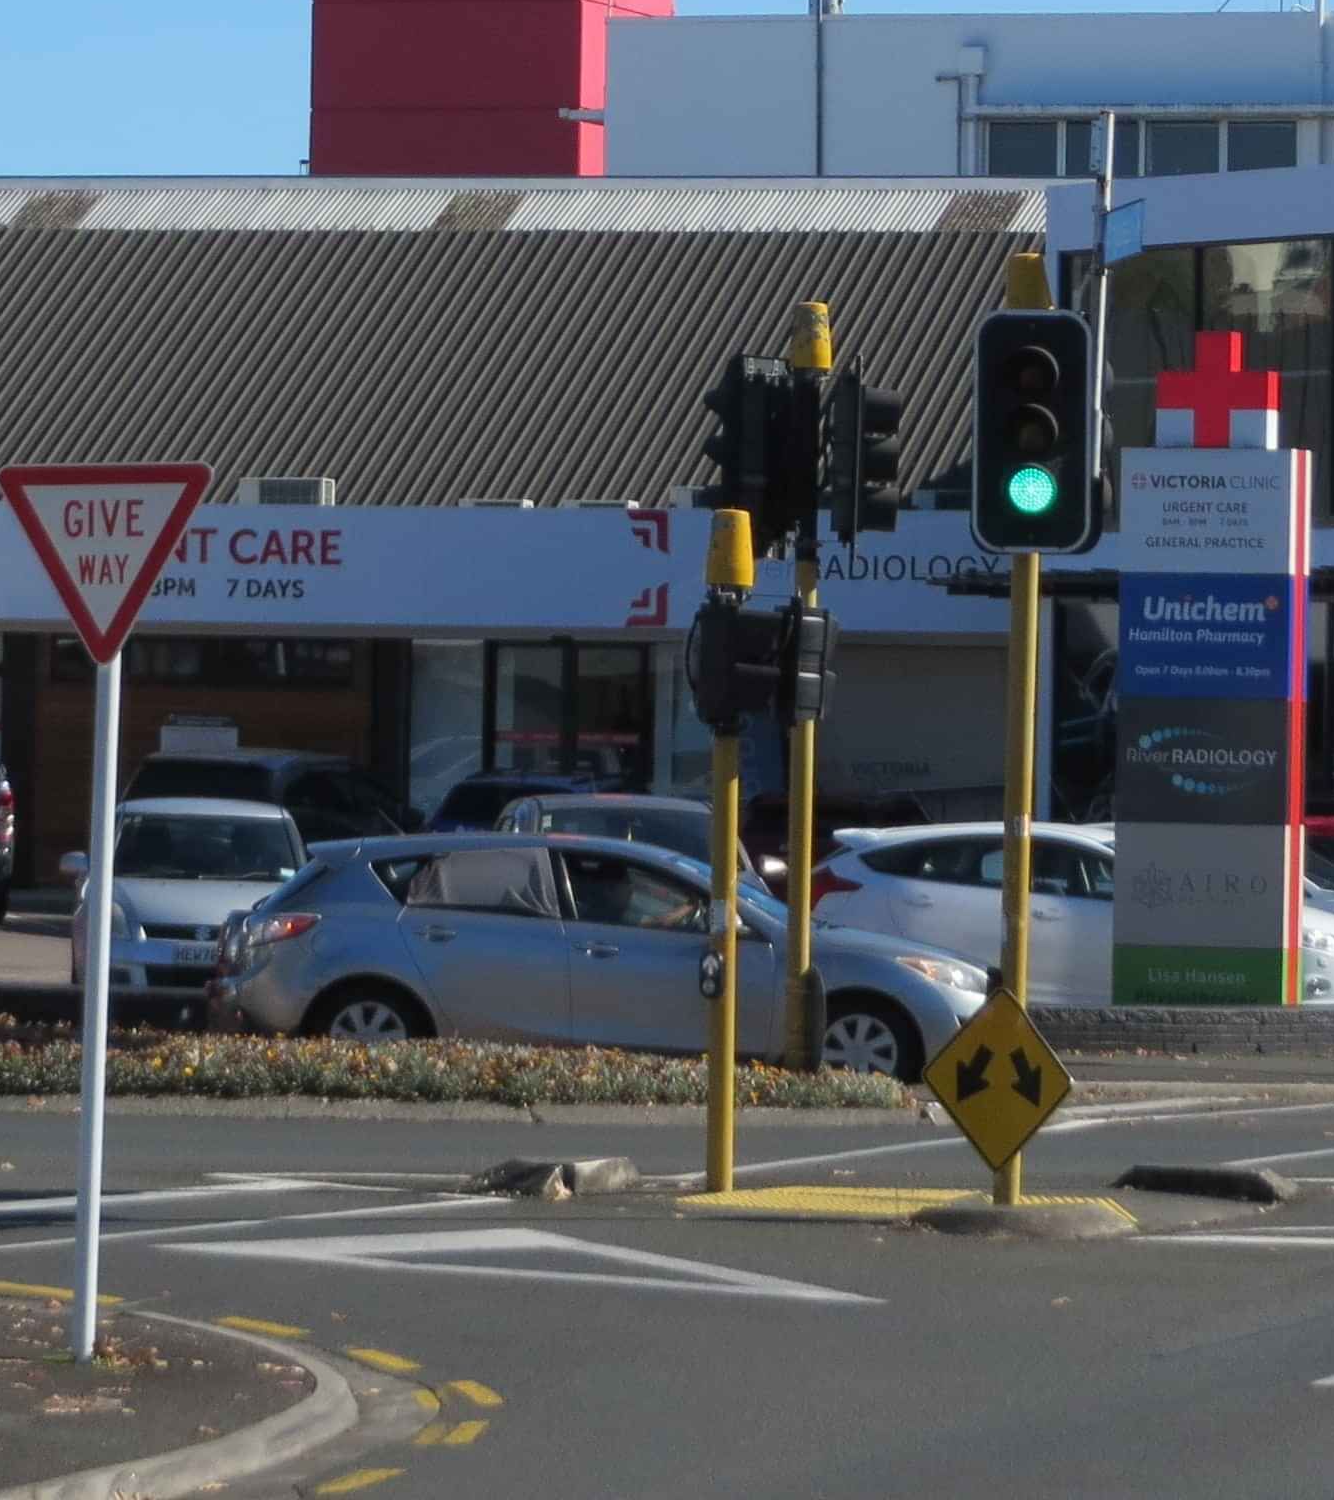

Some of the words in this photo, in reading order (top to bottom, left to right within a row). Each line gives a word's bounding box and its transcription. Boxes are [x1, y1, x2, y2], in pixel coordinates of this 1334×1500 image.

[1150, 474, 1226, 490] VICTORIA
[1229, 474, 1281, 490] CLINIC
[1162, 501, 1213, 513] URGENT
[1216, 501, 1248, 514] CARE
[63, 499, 145, 538] GIVE
[228, 528, 343, 566] CARE
[1145, 536, 1201, 549] GENERAL
[1204, 537, 1267, 550] PRACTICE
[78, 554, 130, 585] WAY
[226, 578, 239, 597] 7
[245, 578, 305, 598] DAYS
[1143, 595, 1266, 622] Unichem
[1128, 627, 1194, 642] Hamilton
[1196, 628, 1265, 646] Pharmacy
[1125, 747, 1168, 763] River
[1171, 748, 1278, 765] RADIOLOGY
